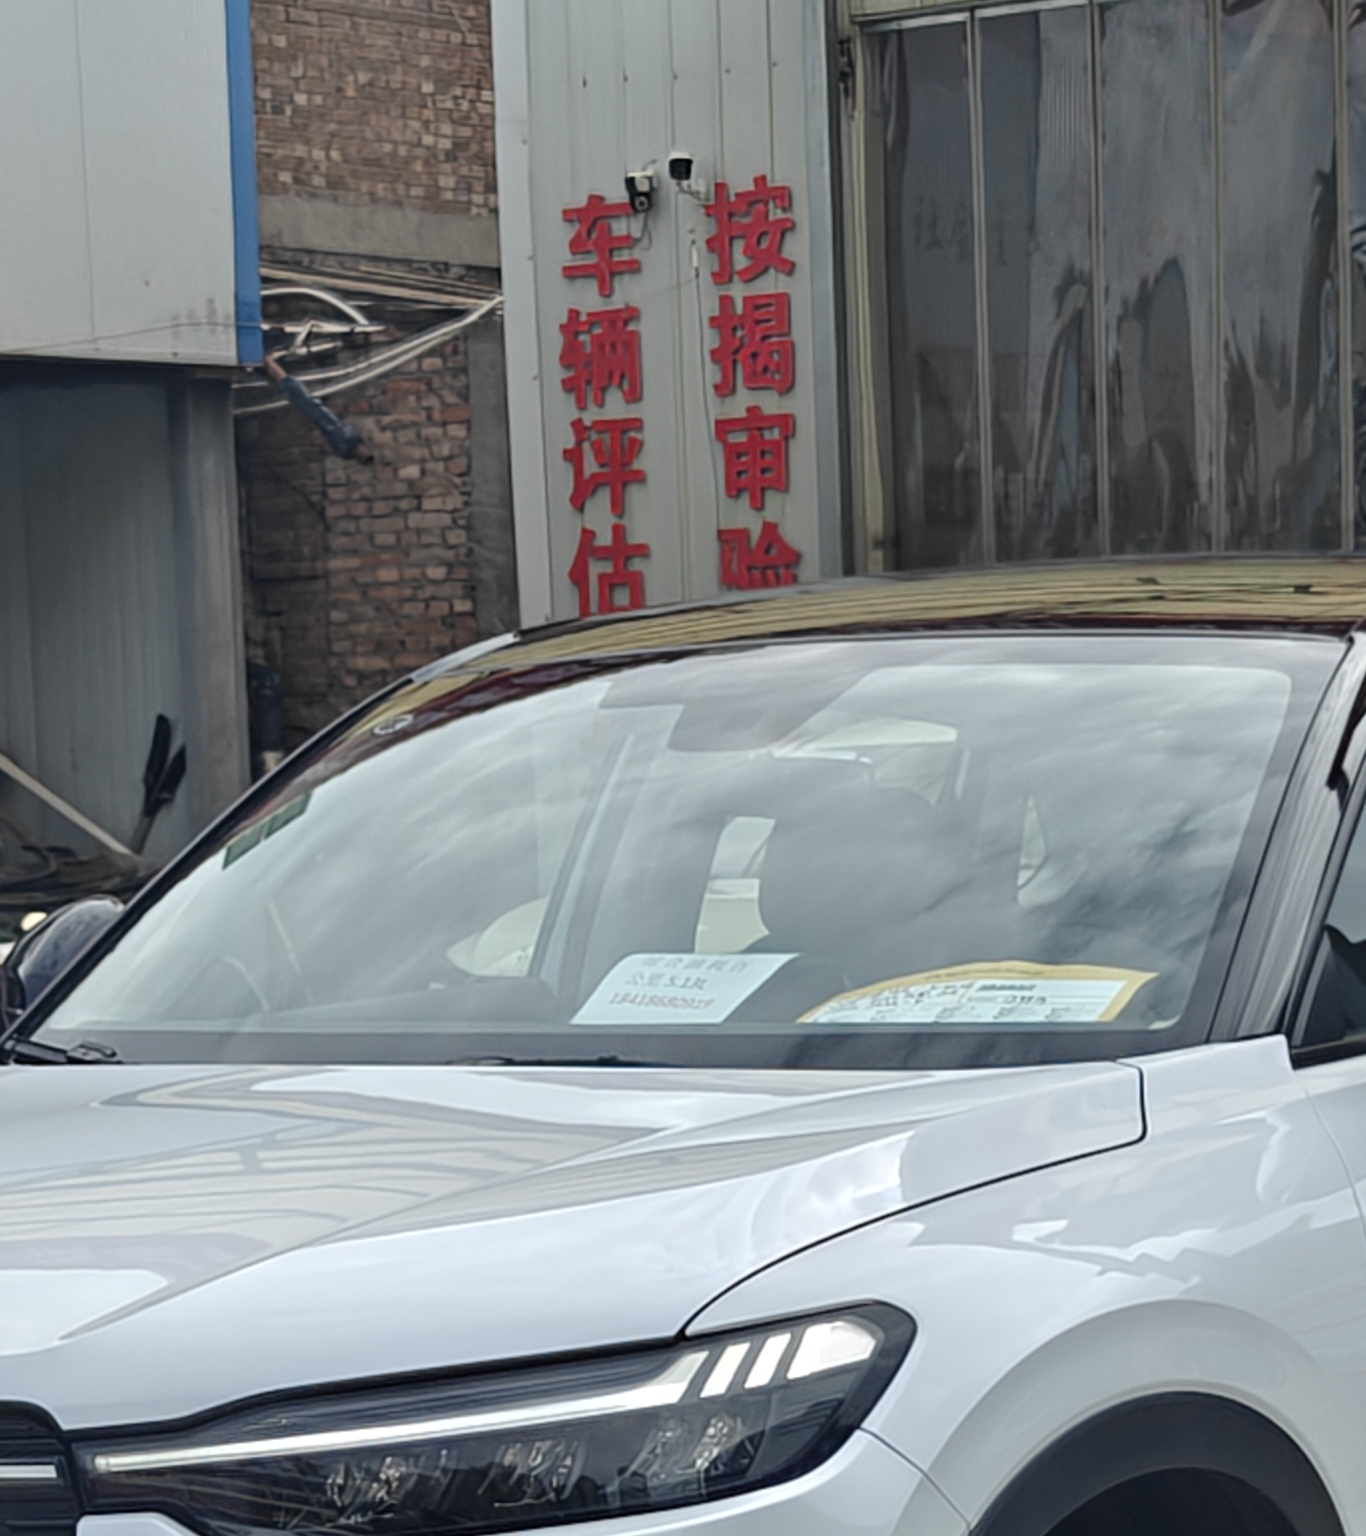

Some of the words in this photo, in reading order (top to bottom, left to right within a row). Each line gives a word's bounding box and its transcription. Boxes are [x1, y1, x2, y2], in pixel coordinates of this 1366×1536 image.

[559, 194, 649, 618] 车辆评估
[705, 175, 802, 590] 按揭审验
